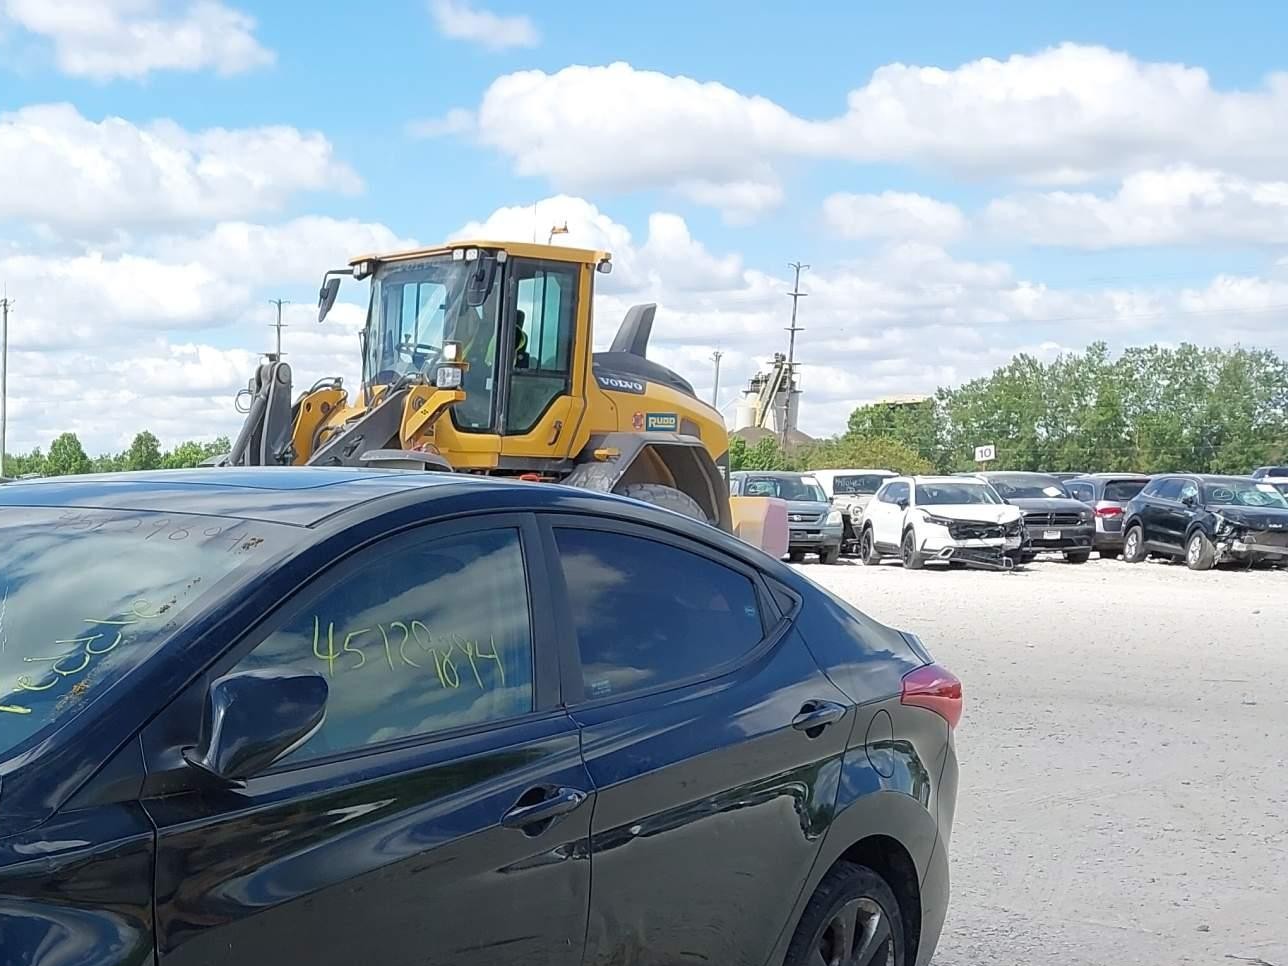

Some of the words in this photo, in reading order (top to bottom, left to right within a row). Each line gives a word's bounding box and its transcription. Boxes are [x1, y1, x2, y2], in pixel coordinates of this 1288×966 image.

[598, 377, 643, 391] VOLVO
[648, 416, 676, 428] RUDD
[979, 448, 992, 458] 10
